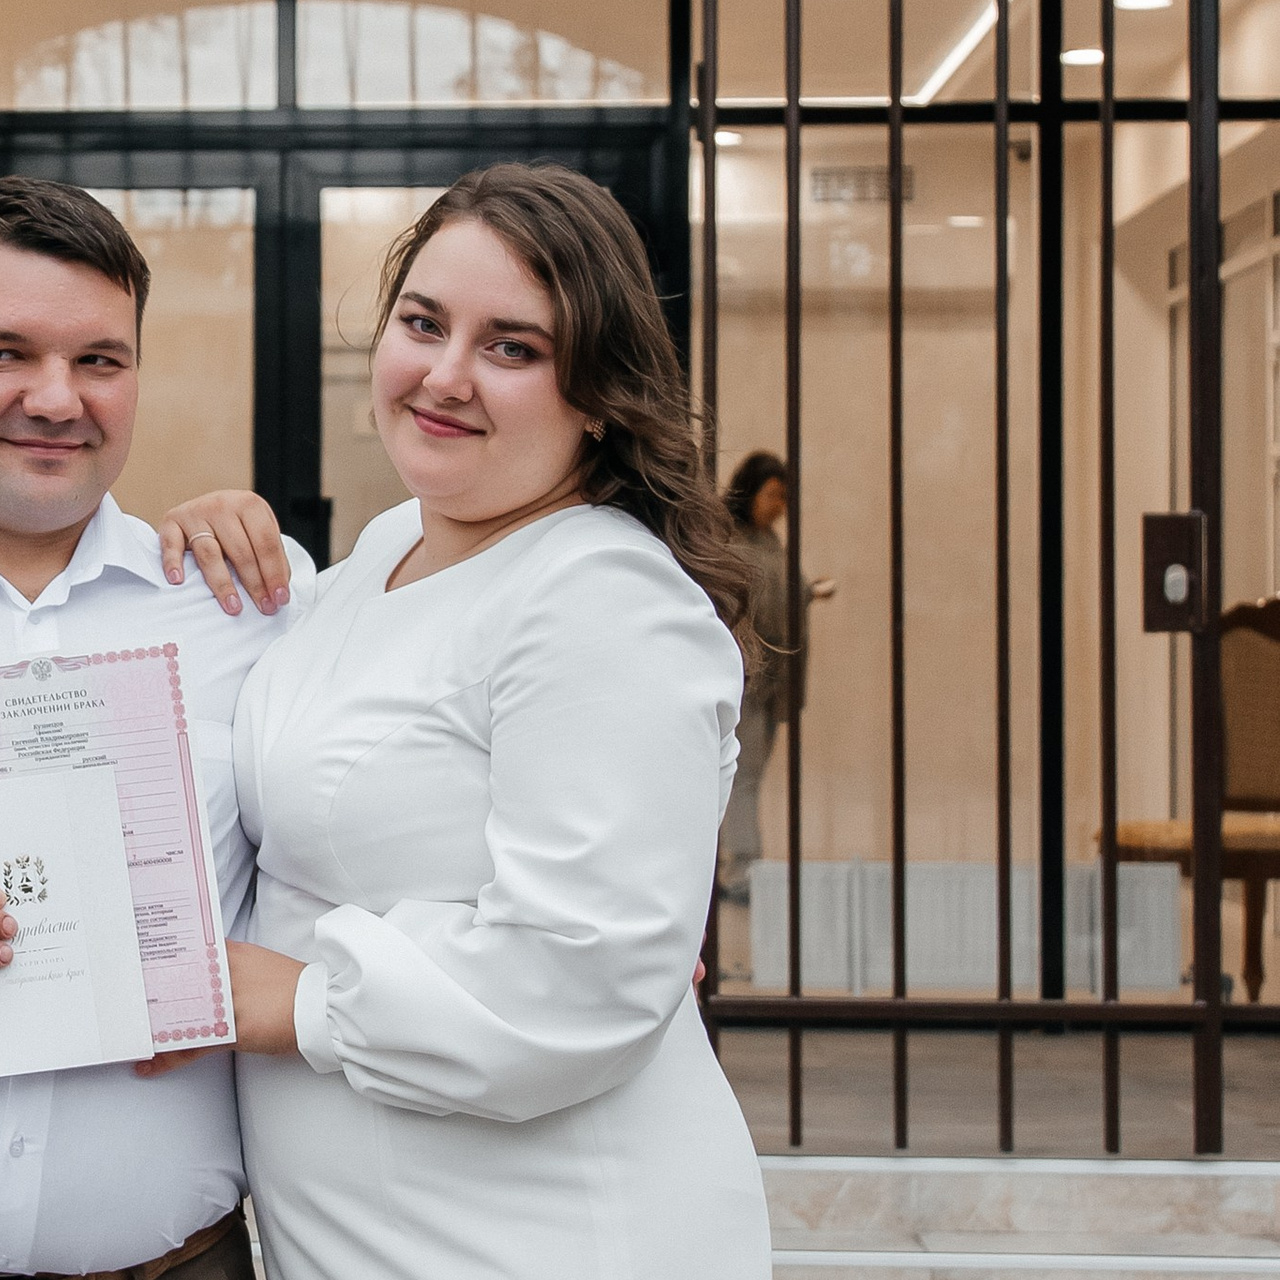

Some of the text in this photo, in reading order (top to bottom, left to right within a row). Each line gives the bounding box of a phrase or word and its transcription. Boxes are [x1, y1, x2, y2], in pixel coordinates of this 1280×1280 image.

[4, 688, 88, 707] СВИДЕТЕЛЬСТВО
[0, 703, 71, 719] ЗАКЛЮЧЕНИИ
[73, 698, 106, 710] БРАКА
